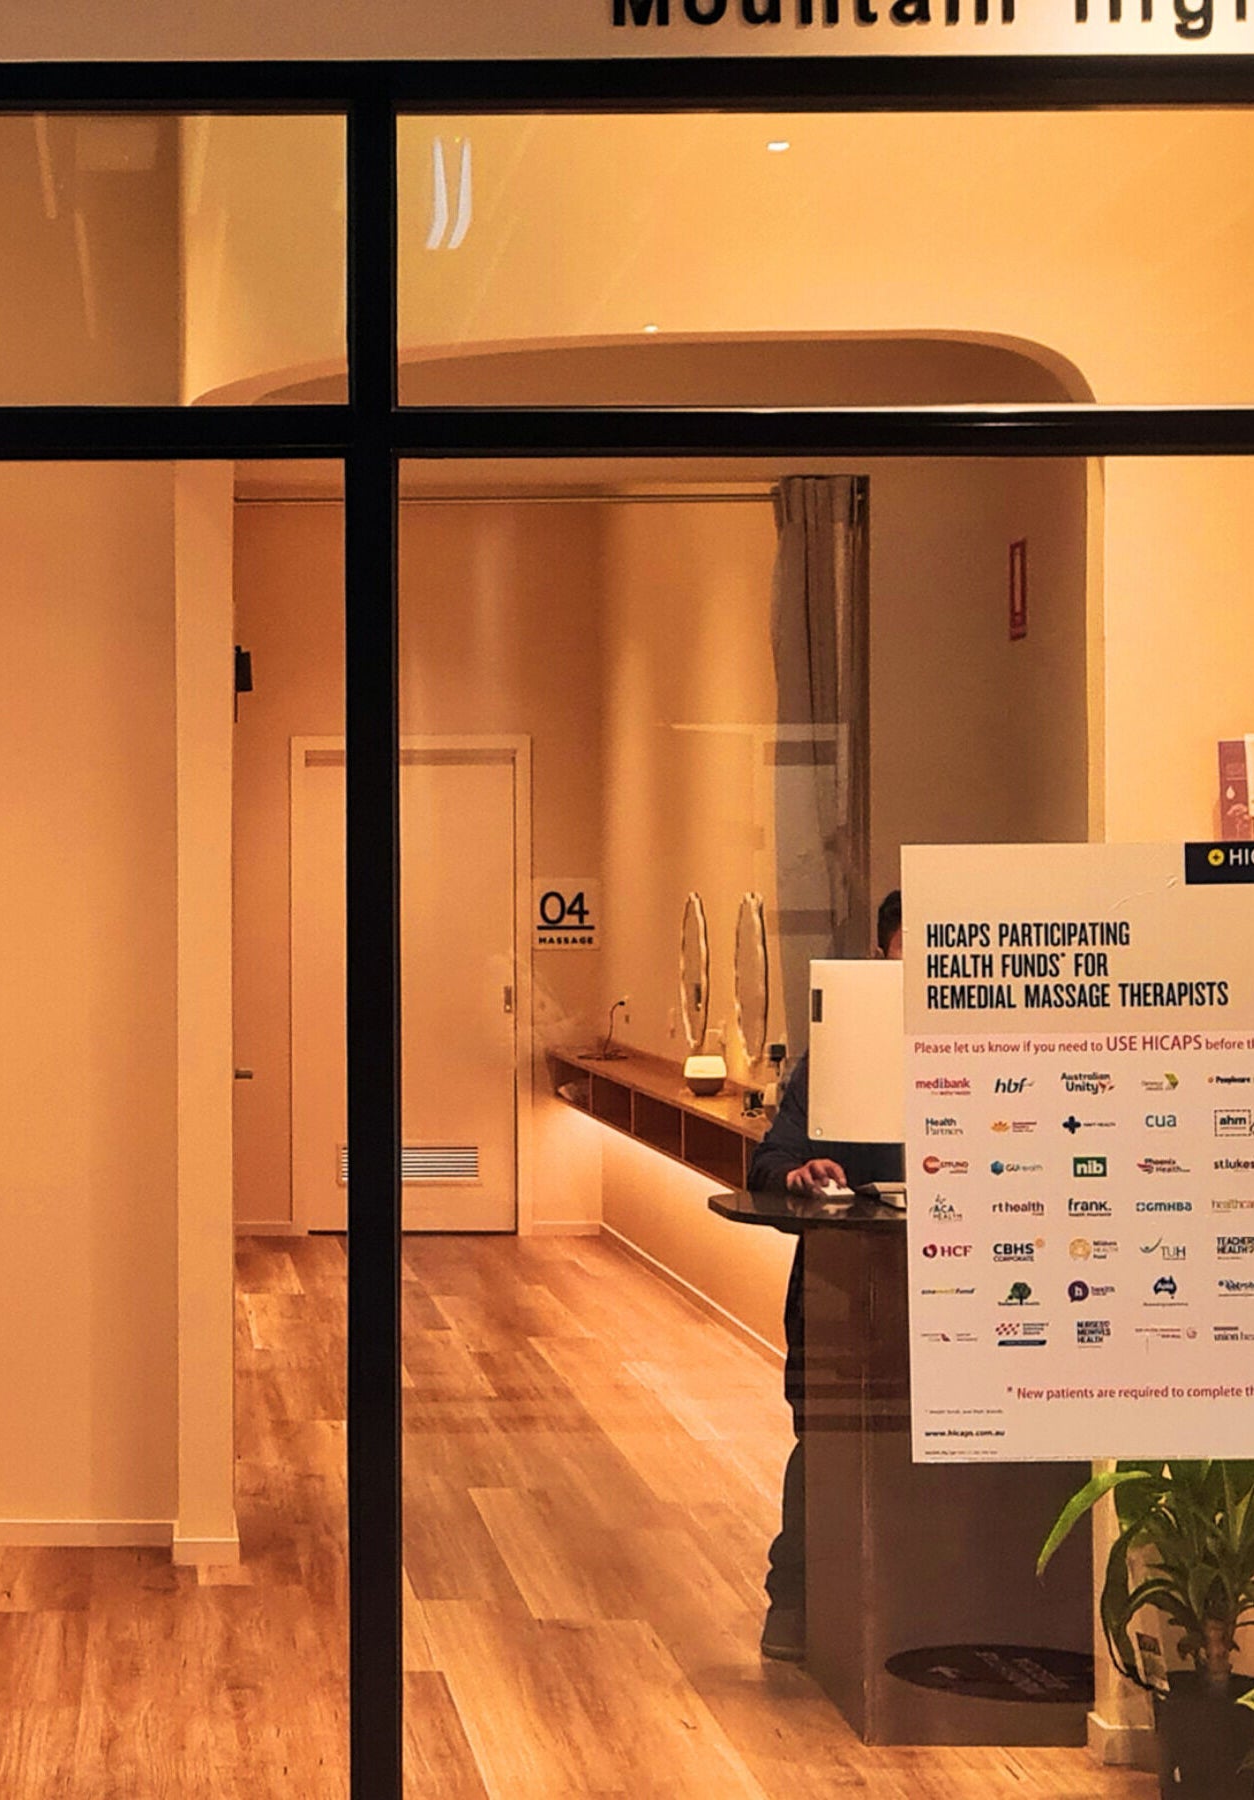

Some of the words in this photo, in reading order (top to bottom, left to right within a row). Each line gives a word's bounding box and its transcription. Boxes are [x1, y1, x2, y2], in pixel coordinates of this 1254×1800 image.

[540, 891, 590, 925] 04
[538, 936, 594, 944] MASSAGE
[926, 922, 991, 948] HICAPS
[999, 921, 1130, 947] PARTICIPATING
[927, 954, 994, 979] HEALTH
[1074, 953, 1109, 977] FOR
[927, 984, 1016, 1010] REMEDIAL
[1025, 983, 1110, 1008] MASSAGE
[1118, 981, 1229, 1006] THERAPISTS
[914, 1042, 951, 1054] Please
[953, 1042, 969, 1053] let
[971, 1043, 986, 1053] us
[988, 1041, 1020, 1053] know
[1023, 1040, 1032, 1052] if
[1034, 1043, 1055, 1055] you
[1058, 1041, 1088, 1052] need
[1091, 1041, 1103, 1052] to
[1106, 1035, 1138, 1052] USE
[1142, 1035, 1202, 1051] HICAPS
[1206, 1038, 1244, 1050] before
[1247, 1039, 1254, 1049] t
[1060, 1072, 1111, 1081] Australian
[915, 1077, 971, 1089] medibank
[994, 1077, 1028, 1094] hbf
[1065, 1080, 1099, 1095] Unity
[925, 1117, 957, 1127] Health
[1145, 1114, 1177, 1128] cua
[1219, 1115, 1247, 1126] ahm
[1076, 1160, 1104, 1175] nib
[934, 1204, 955, 1213] ACA
[1005, 1201, 1045, 1213] health
[1068, 1198, 1112, 1212] frank.
[940, 1245, 973, 1257] HCF
[992, 1243, 1035, 1255] CBHS
[1160, 1245, 1187, 1257] TUH
[1216, 1245, 1249, 1254] HEALTH
[1017, 1387, 1044, 1399] New
[1047, 1387, 1094, 1401] patients
[1097, 1389, 1116, 1398] are
[1118, 1386, 1169, 1400] required
[1171, 1387, 1184, 1398] to
[1186, 1385, 1242, 1400] complete
[924, 1429, 1006, 1438] www.hicaps.com.au
